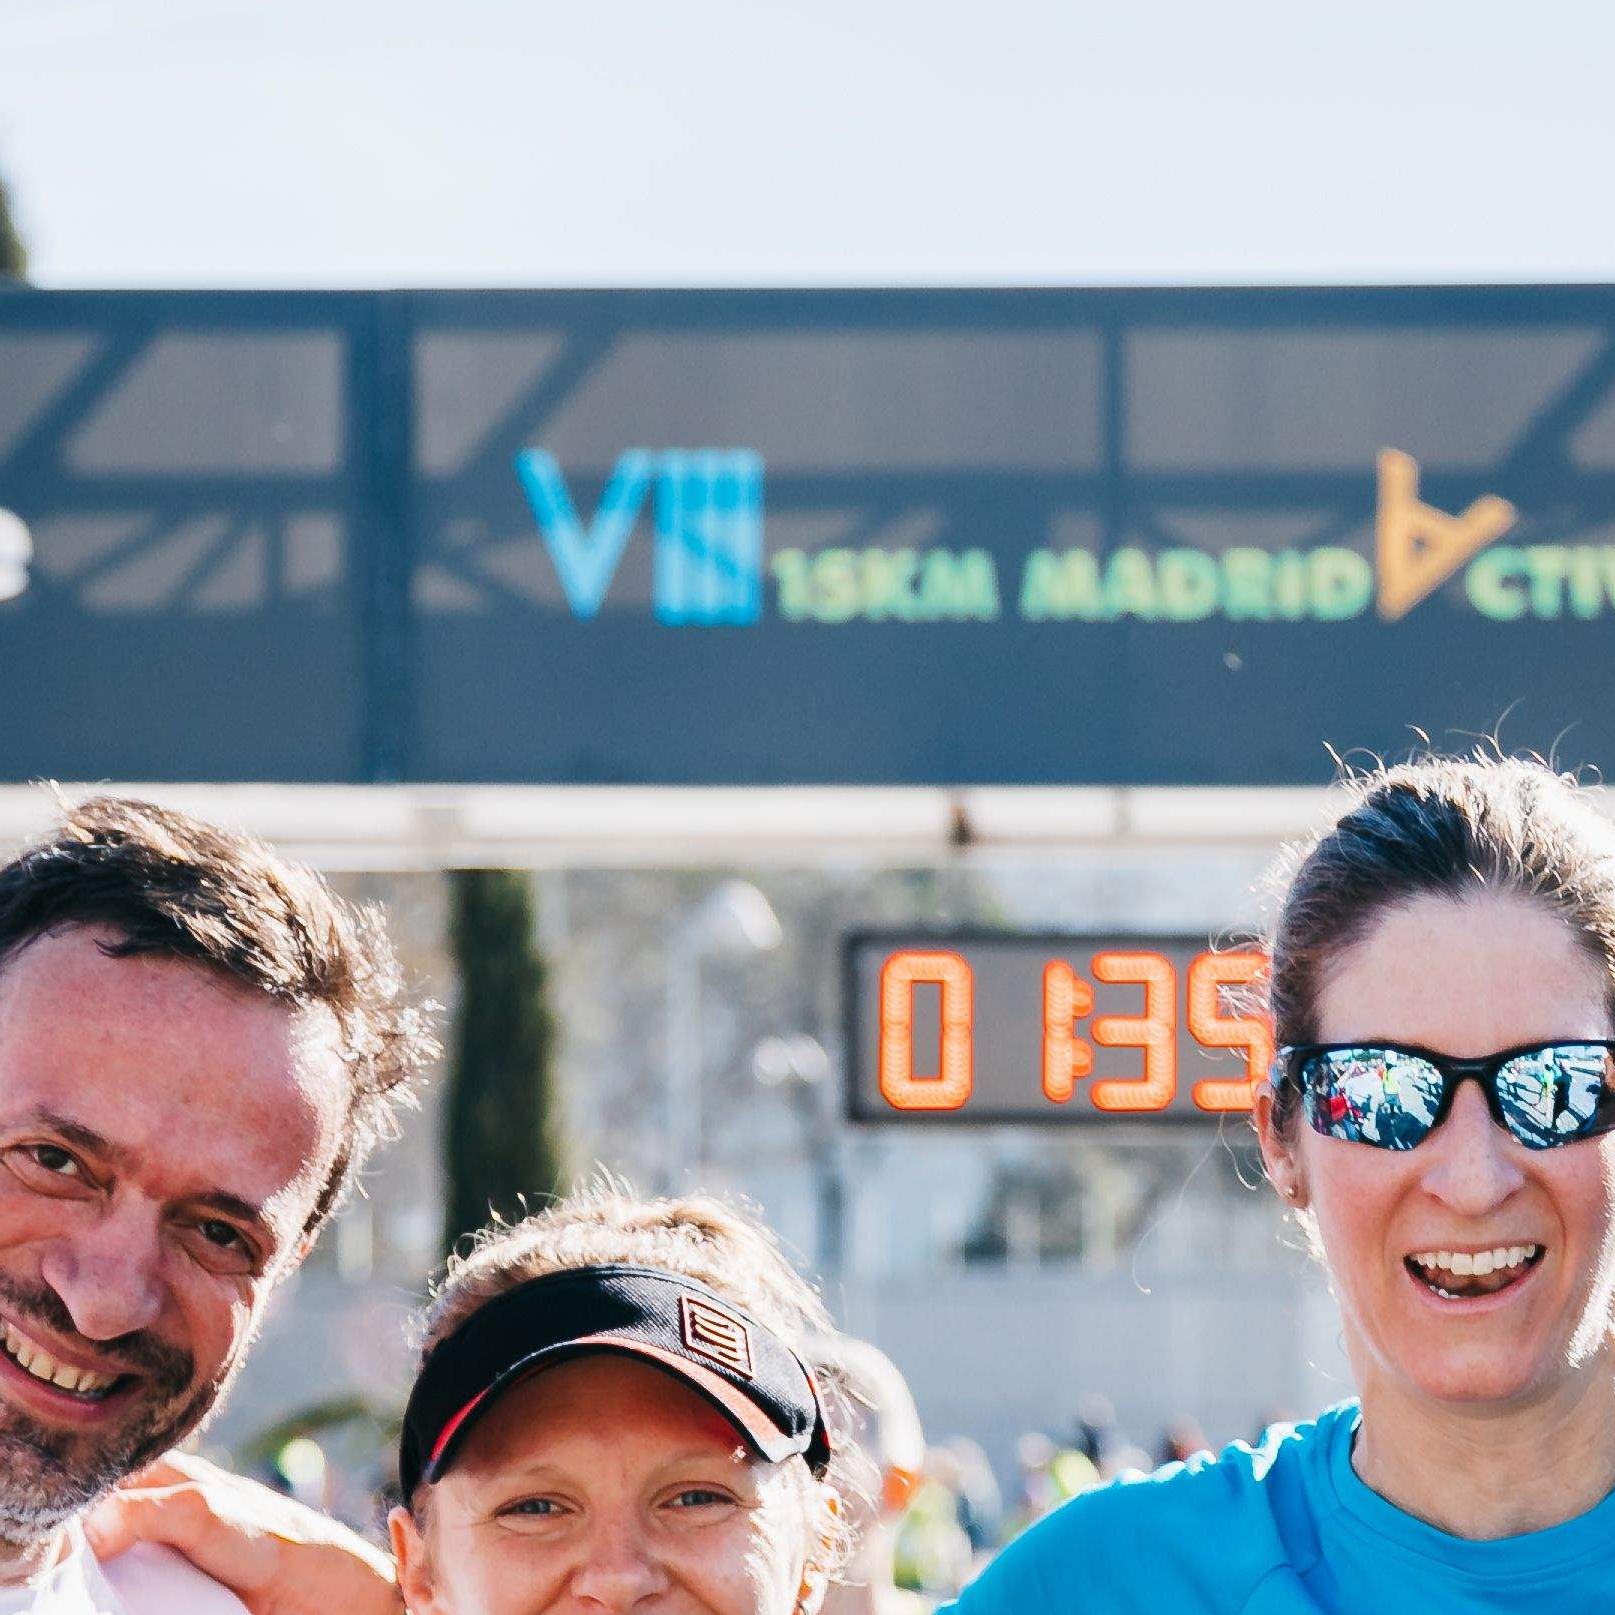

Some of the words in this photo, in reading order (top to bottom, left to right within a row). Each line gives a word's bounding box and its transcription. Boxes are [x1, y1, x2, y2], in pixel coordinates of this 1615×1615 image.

[516, 447, 765, 626] VIII
[774, 547, 1001, 623] 15KM
[1019, 547, 1375, 622] MADRID
